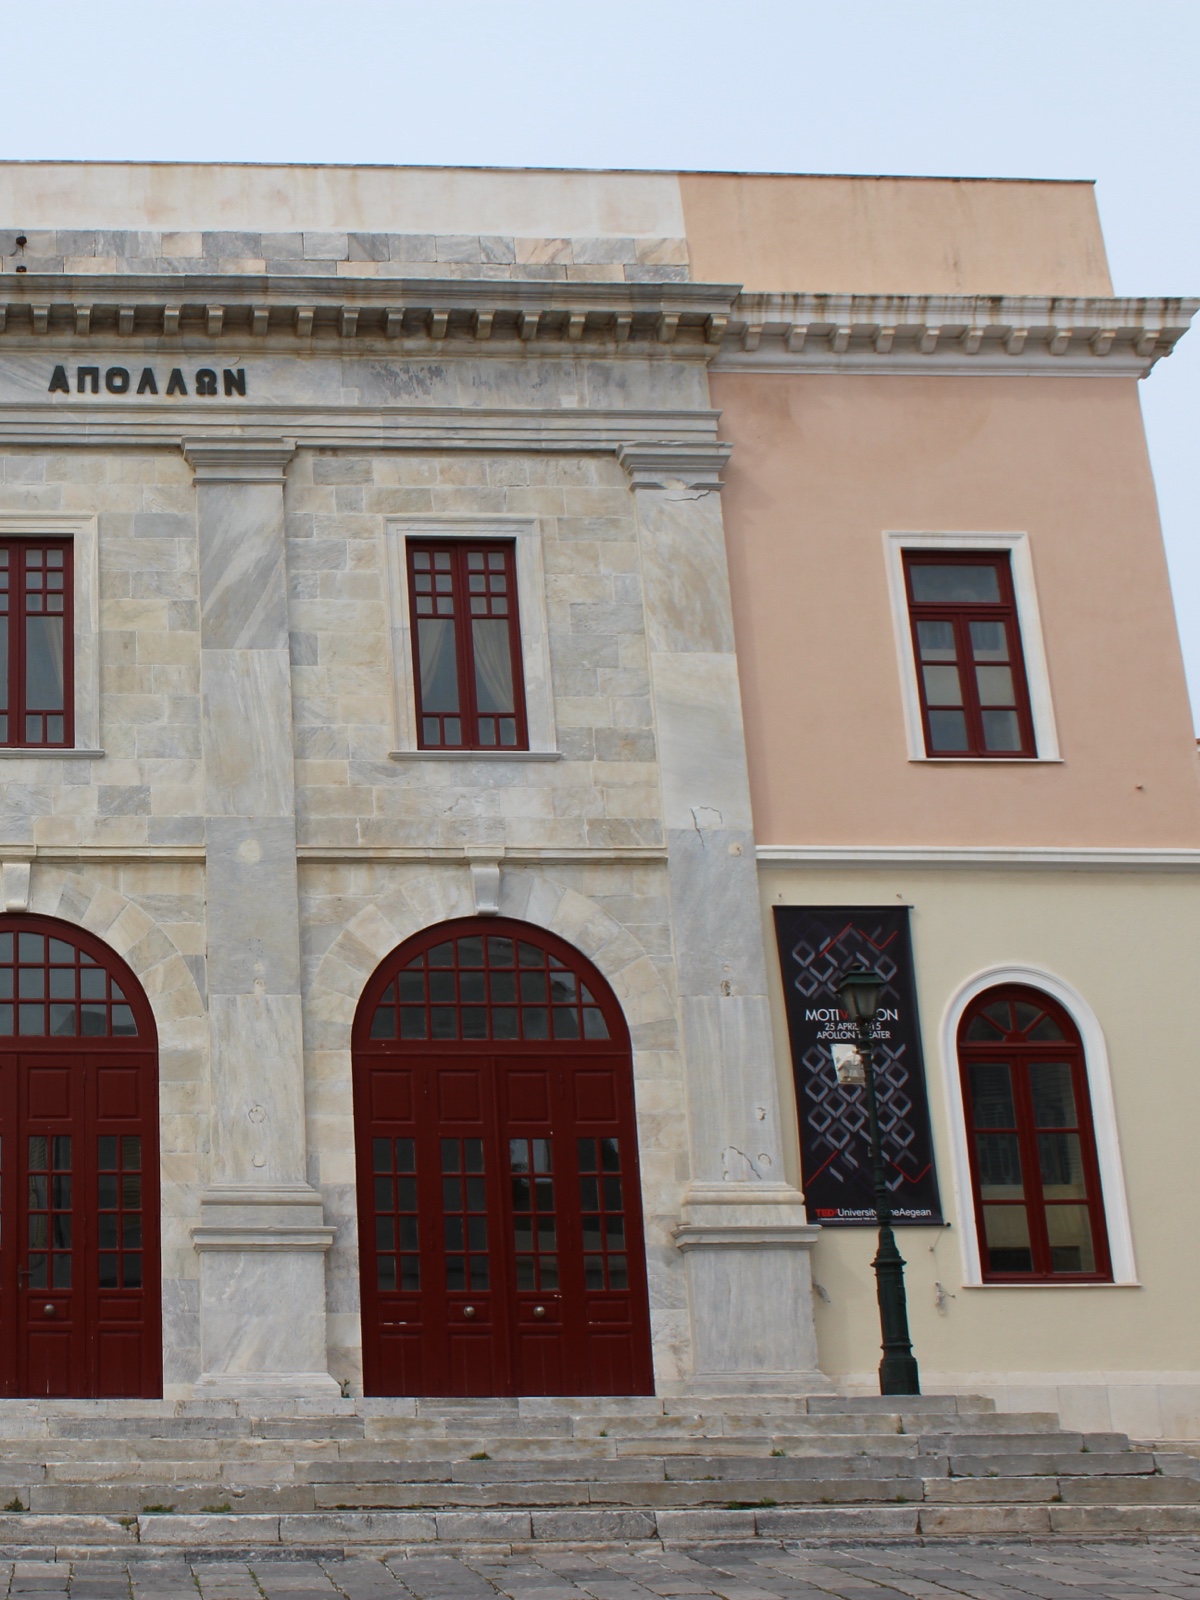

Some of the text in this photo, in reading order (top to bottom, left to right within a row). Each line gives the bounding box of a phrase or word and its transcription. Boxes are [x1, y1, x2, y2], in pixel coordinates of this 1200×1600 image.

[47, 365, 247, 396] ΑΠΟΛΛΩΝ
[805, 1008, 899, 1021] MOTIVON
[824, 1022, 836, 1031] 25
[837, 1022, 860, 1031] APRIL
[816, 1031, 891, 1040] APOLLON TEATER
